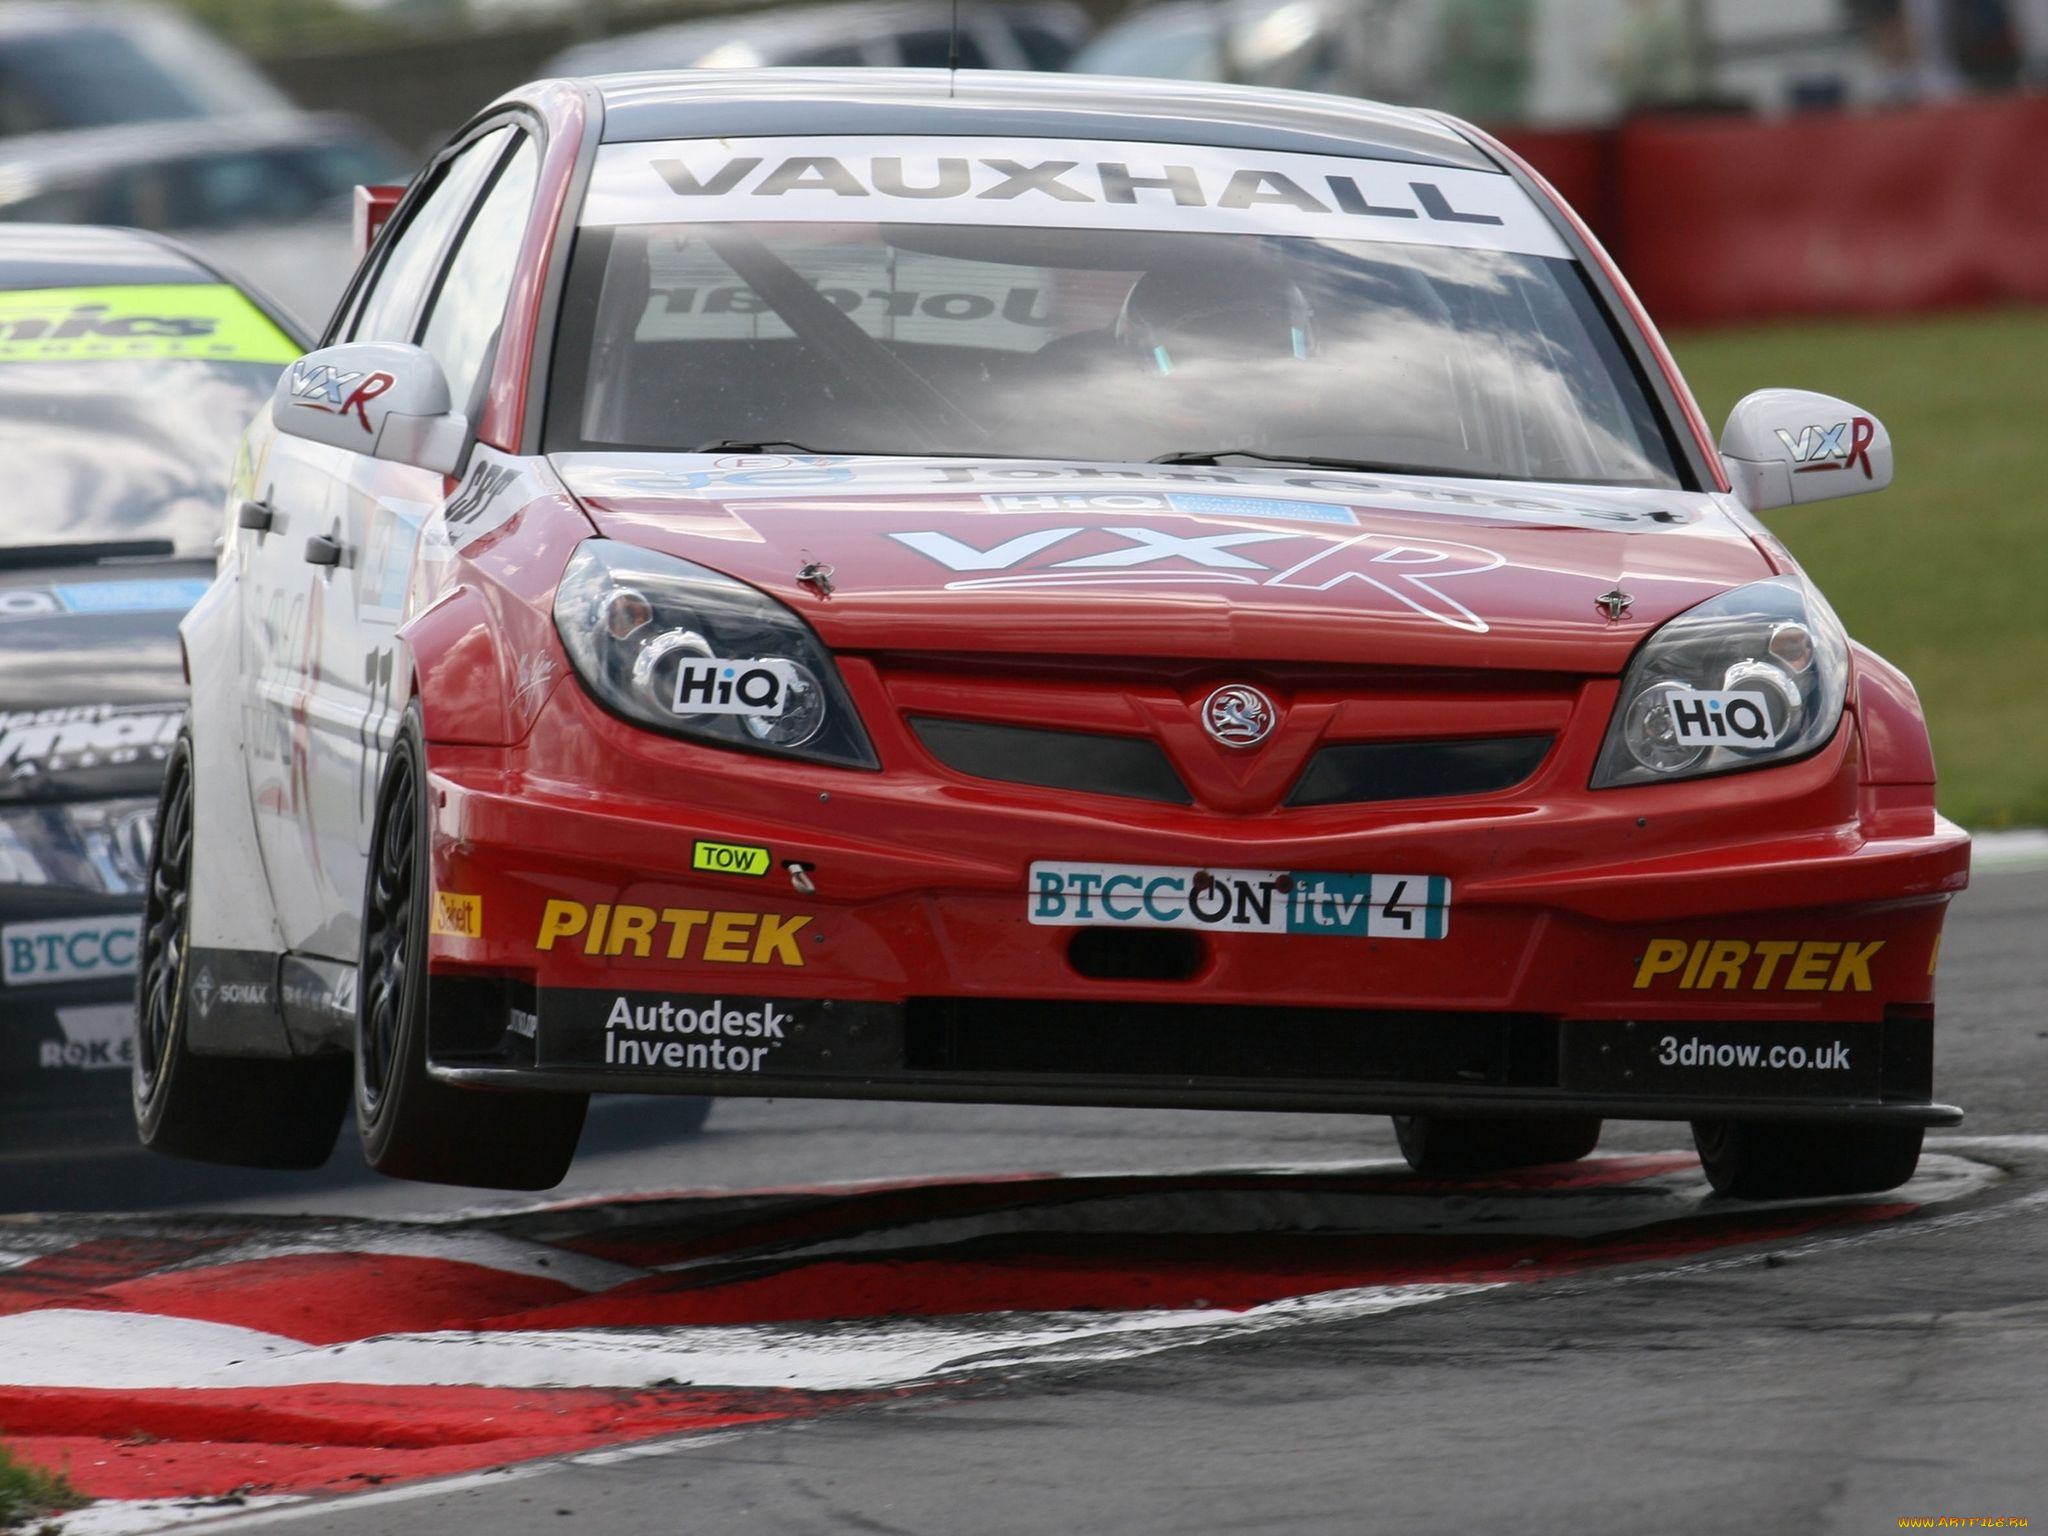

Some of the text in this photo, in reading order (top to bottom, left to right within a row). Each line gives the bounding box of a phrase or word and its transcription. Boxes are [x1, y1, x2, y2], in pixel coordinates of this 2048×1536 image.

[651, 155, 1503, 226] VAUXHALL
[291, 360, 396, 435] VXR
[1775, 417, 1875, 480] VXR
[925, 466, 1248, 485] John
[1284, 477, 1690, 525] Guest
[1000, 494, 1165, 511] HiQ
[887, 527, 1506, 633] VXR
[679, 665, 781, 709] HiQ
[1672, 698, 1769, 741] HiQ
[703, 847, 755, 871] TOW
[1035, 872, 1186, 922] BTCC
[1288, 880, 1372, 927] itv
[1382, 880, 1412, 931] 4
[9, 929, 135, 974] BTCC
[536, 899, 813, 966] PIRTEK
[1632, 938, 1885, 993] PIRTEK
[604, 996, 785, 1038] Autodesk
[604, 1031, 769, 1072] Inventor
[1657, 1036, 1851, 1070] 3dnow.co.uk
